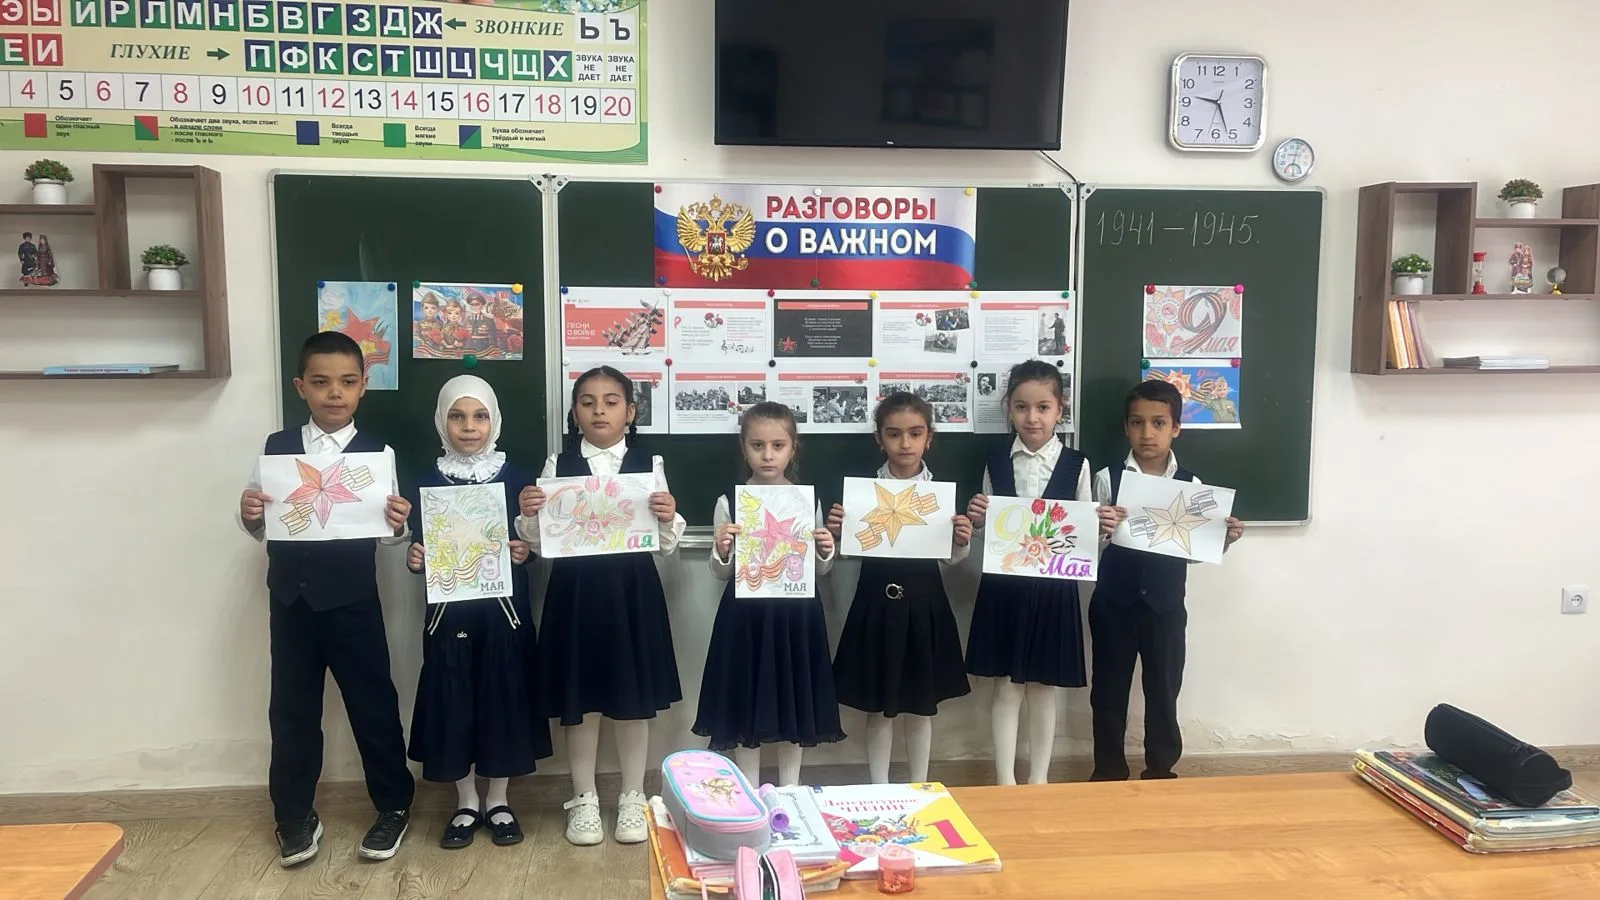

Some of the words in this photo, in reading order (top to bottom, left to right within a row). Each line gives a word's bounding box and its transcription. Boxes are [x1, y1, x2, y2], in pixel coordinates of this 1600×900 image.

[2, 0, 23, 21] Э
[33, 0, 59, 22] Ы
[75, 1, 96, 24] И
[110, 1, 130, 23] Р
[145, 1, 166, 24] Л
[177, 2, 202, 25] М
[213, 3, 235, 26] Н
[247, 5, 269, 28] Б
[282, 6, 304, 29] В
[317, 7, 335, 30] Г
[352, 8, 371, 32] З
[383, 8, 407, 35] Д
[413, 11, 442, 35] Ж
[474, 19, 564, 36] ЗВОНКИЕ
[580, 18, 600, 39] Ь
[609, 18, 631, 41] Ъ
[4, 39, 24, 62] Е
[37, 39, 58, 62] И
[110, 43, 191, 60] ГЛУХИЕ
[250, 44, 271, 68] П
[282, 46, 308, 69] Ф
[318, 47, 338, 70] К
[352, 48, 374, 72] С
[385, 49, 405, 73] Т
[415, 51, 441, 74] Ш
[450, 52, 472, 77] Ц
[484, 53, 504, 76] Ч
[513, 53, 539, 80] Щ
[547, 55, 569, 78] Х
[575, 54, 603, 62] ЗВУКА
[607, 55, 635, 63] ЗВУКА
[1197, 65, 1207, 76] 11
[1213, 65, 1226, 76] 12
[1234, 66, 1239, 76] 1
[578, 73, 601, 81] ДАЕТ
[610, 74, 633, 82] ДАЕТ
[1182, 78, 1195, 89] 10
[1245, 79, 1255, 90] 2
[21, 78, 35, 99] 4
[59, 79, 74, 101] 5
[96, 80, 111, 101] 6
[135, 81, 150, 102] 7
[173, 82, 188, 103] 8
[211, 83, 226, 104] 9
[242, 85, 271, 106] 10
[282, 86, 305, 107] 11
[317, 87, 345, 108] 12
[354, 88, 382, 109] 13
[390, 89, 418, 110] 14
[427, 90, 454, 112] 15
[463, 92, 490, 113] 16
[499, 93, 525, 114] 17
[535, 94, 561, 114] 18
[570, 95, 598, 115] 19
[603, 96, 632, 117] 20
[1181, 96, 1192, 107] 9
[1243, 97, 1253, 108] 3
[169, 116, 207, 124] Обозначает
[331, 122, 353, 130] Всегда
[1180, 115, 1191, 126] 8
[1242, 117, 1252, 127] 4
[1194, 128, 1204, 139] 7
[1211, 129, 1221, 139] 6
[1228, 129, 1238, 139] 5
[766, 195, 937, 220] РАЗГОВОРЫ
[765, 227, 788, 254] О
[800, 227, 937, 255] ВАЖНОМ
[1040, 554, 1092, 577] Мая
[481, 581, 504, 592] МАЯ
[784, 582, 806, 592] МАЯ
[924, 819, 978, 850] 1
